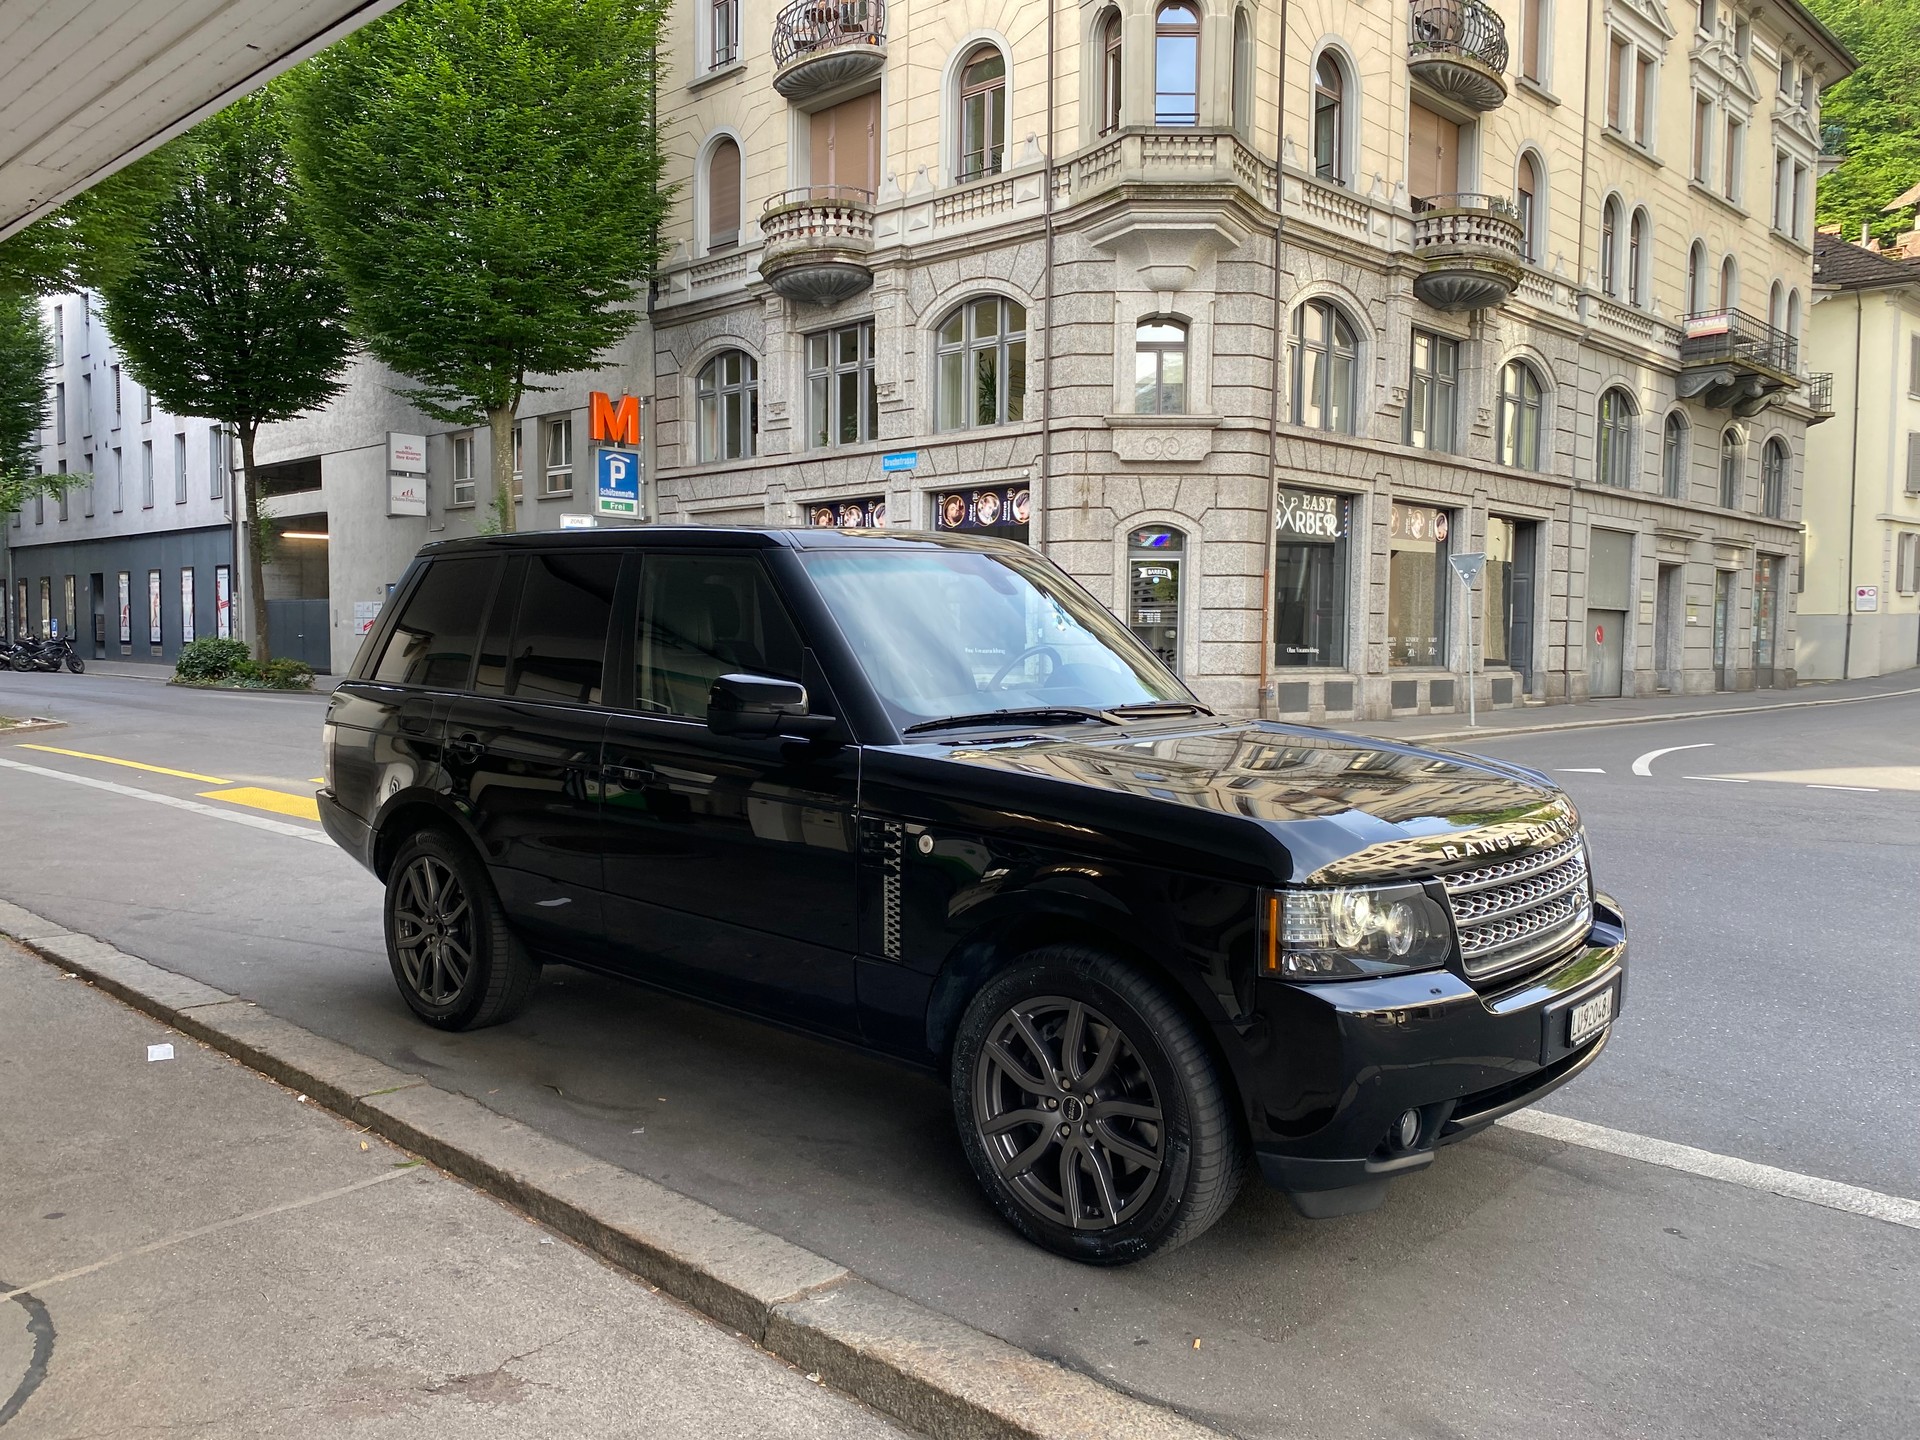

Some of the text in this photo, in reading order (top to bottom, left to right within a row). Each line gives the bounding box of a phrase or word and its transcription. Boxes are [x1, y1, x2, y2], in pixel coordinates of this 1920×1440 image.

[1689, 320, 1703, 329] NO
[589, 391, 640, 445] M
[610, 460, 626, 488] P
[600, 487, 635, 499] Schützenmatte
[610, 502, 625, 510] Frei
[1302, 494, 1334, 513] EASY
[1441, 813, 1572, 860] RANGE ROVER
